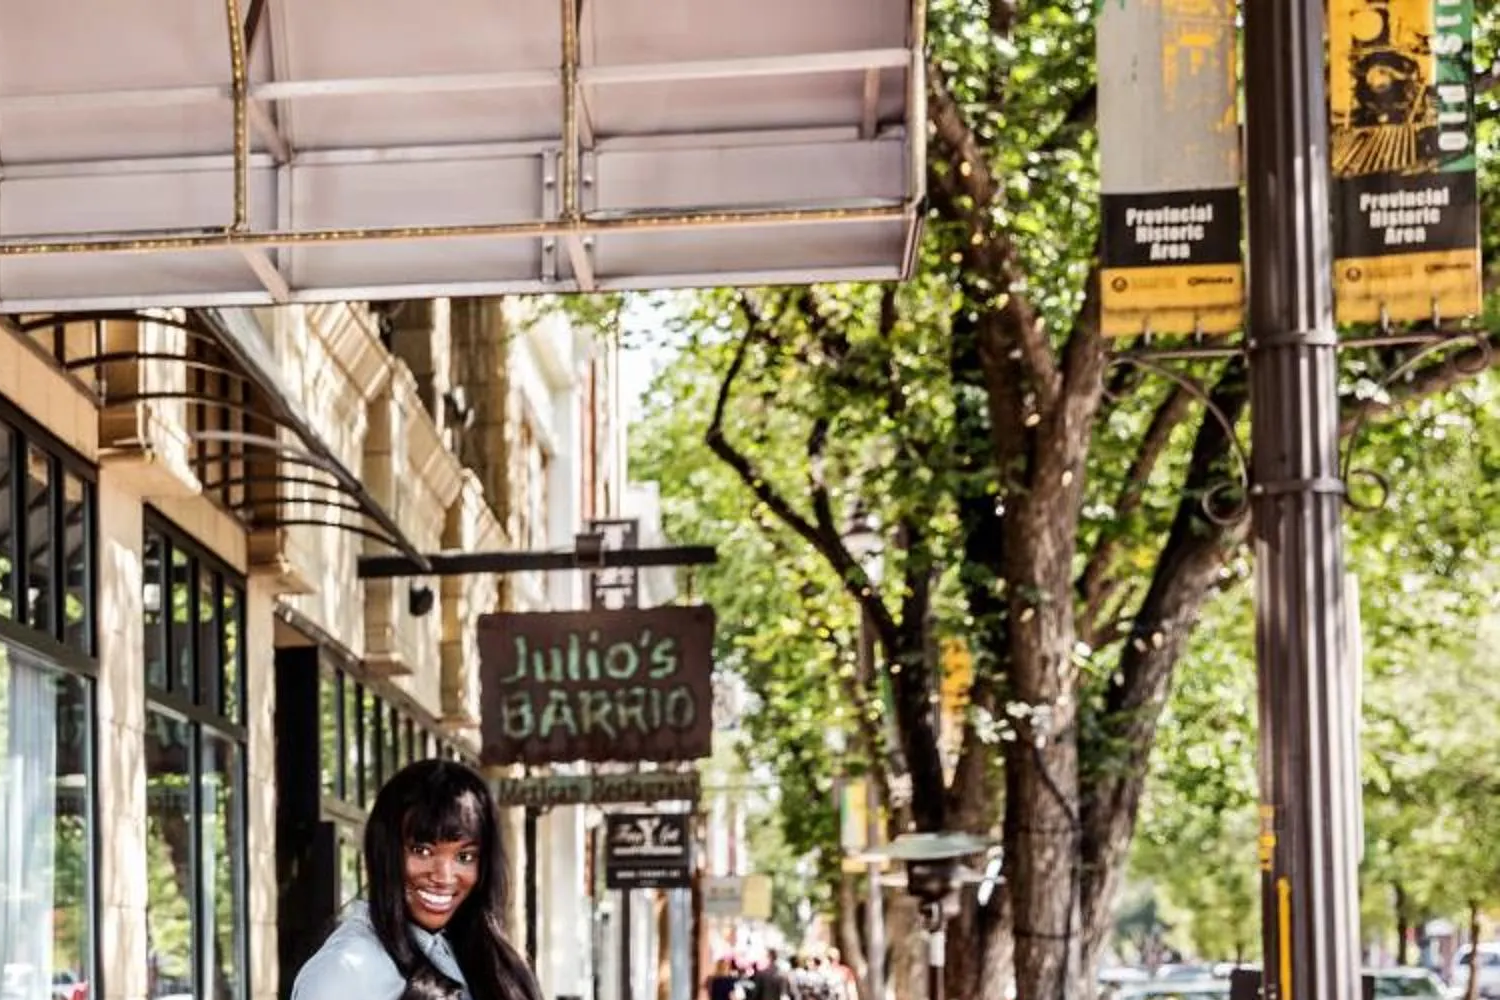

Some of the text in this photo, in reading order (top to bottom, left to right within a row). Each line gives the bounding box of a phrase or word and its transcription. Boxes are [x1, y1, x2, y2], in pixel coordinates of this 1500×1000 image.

[1359, 186, 1449, 213] Provincial
[1125, 203, 1213, 227] Provincial
[1369, 206, 1441, 229] Historic
[1135, 223, 1205, 243] Historic
[1384, 226, 1426, 245] Area
[1149, 242, 1191, 260] Area
[499, 629, 678, 684] Julio's
[501, 685, 696, 740] BARRIO
